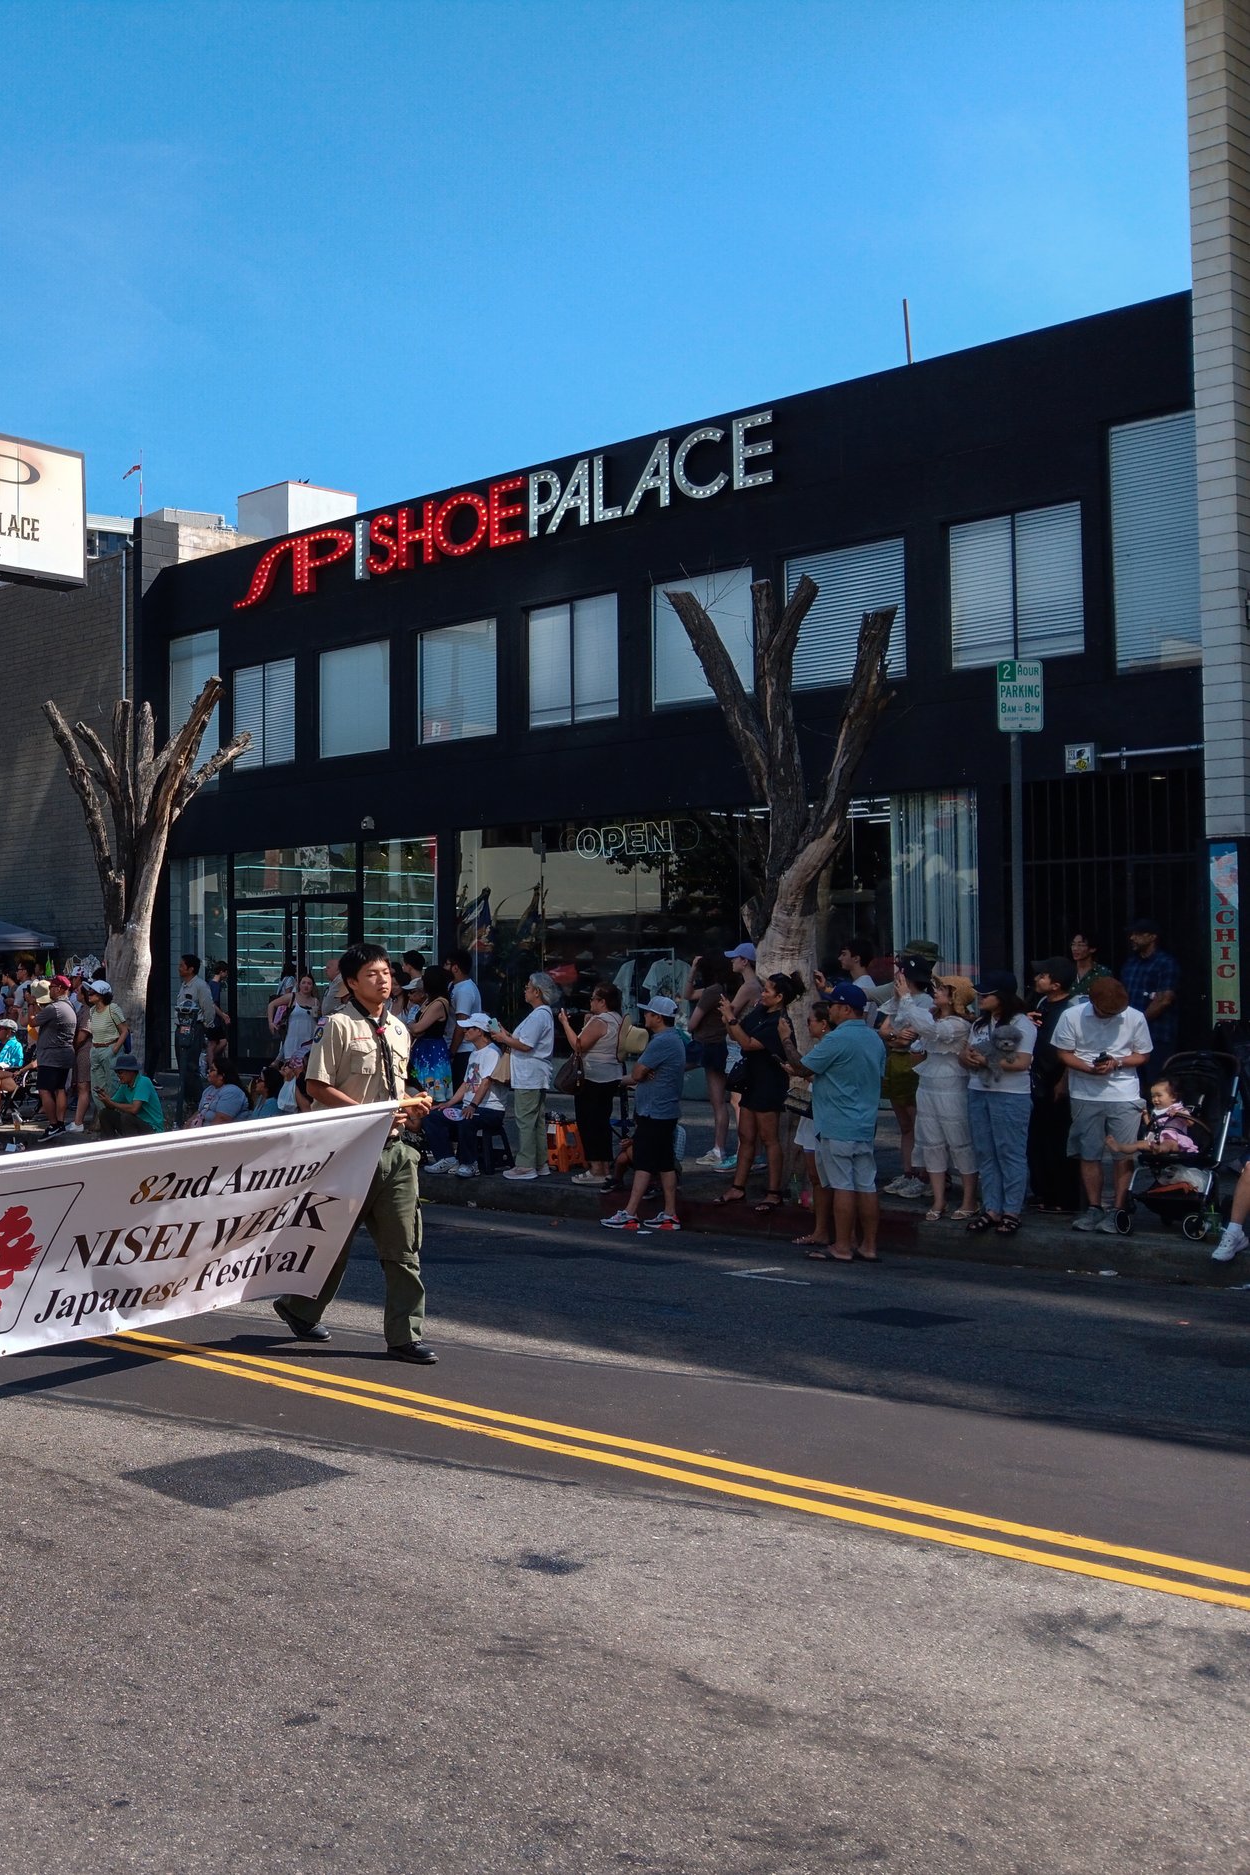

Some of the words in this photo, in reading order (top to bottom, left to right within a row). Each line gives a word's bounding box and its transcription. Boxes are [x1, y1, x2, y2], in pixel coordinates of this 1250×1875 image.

[1000, 684, 1040, 698] PARKING
[1002, 663, 1011, 679] 2
[1017, 665, 1039, 676] HOUR
[1000, 702, 1017, 713] 8AM
[1024, 702, 1040, 713] 8PM
[575, 820, 673, 860] OPEN
[129, 1166, 219, 1205] 82nd
[220, 1151, 335, 1196] Annual
[56, 1220, 205, 1274] NISEI
[212, 1191, 341, 1251] WEEK
[34, 1273, 188, 1328] Japanese
[193, 1245, 317, 1292] Festival
